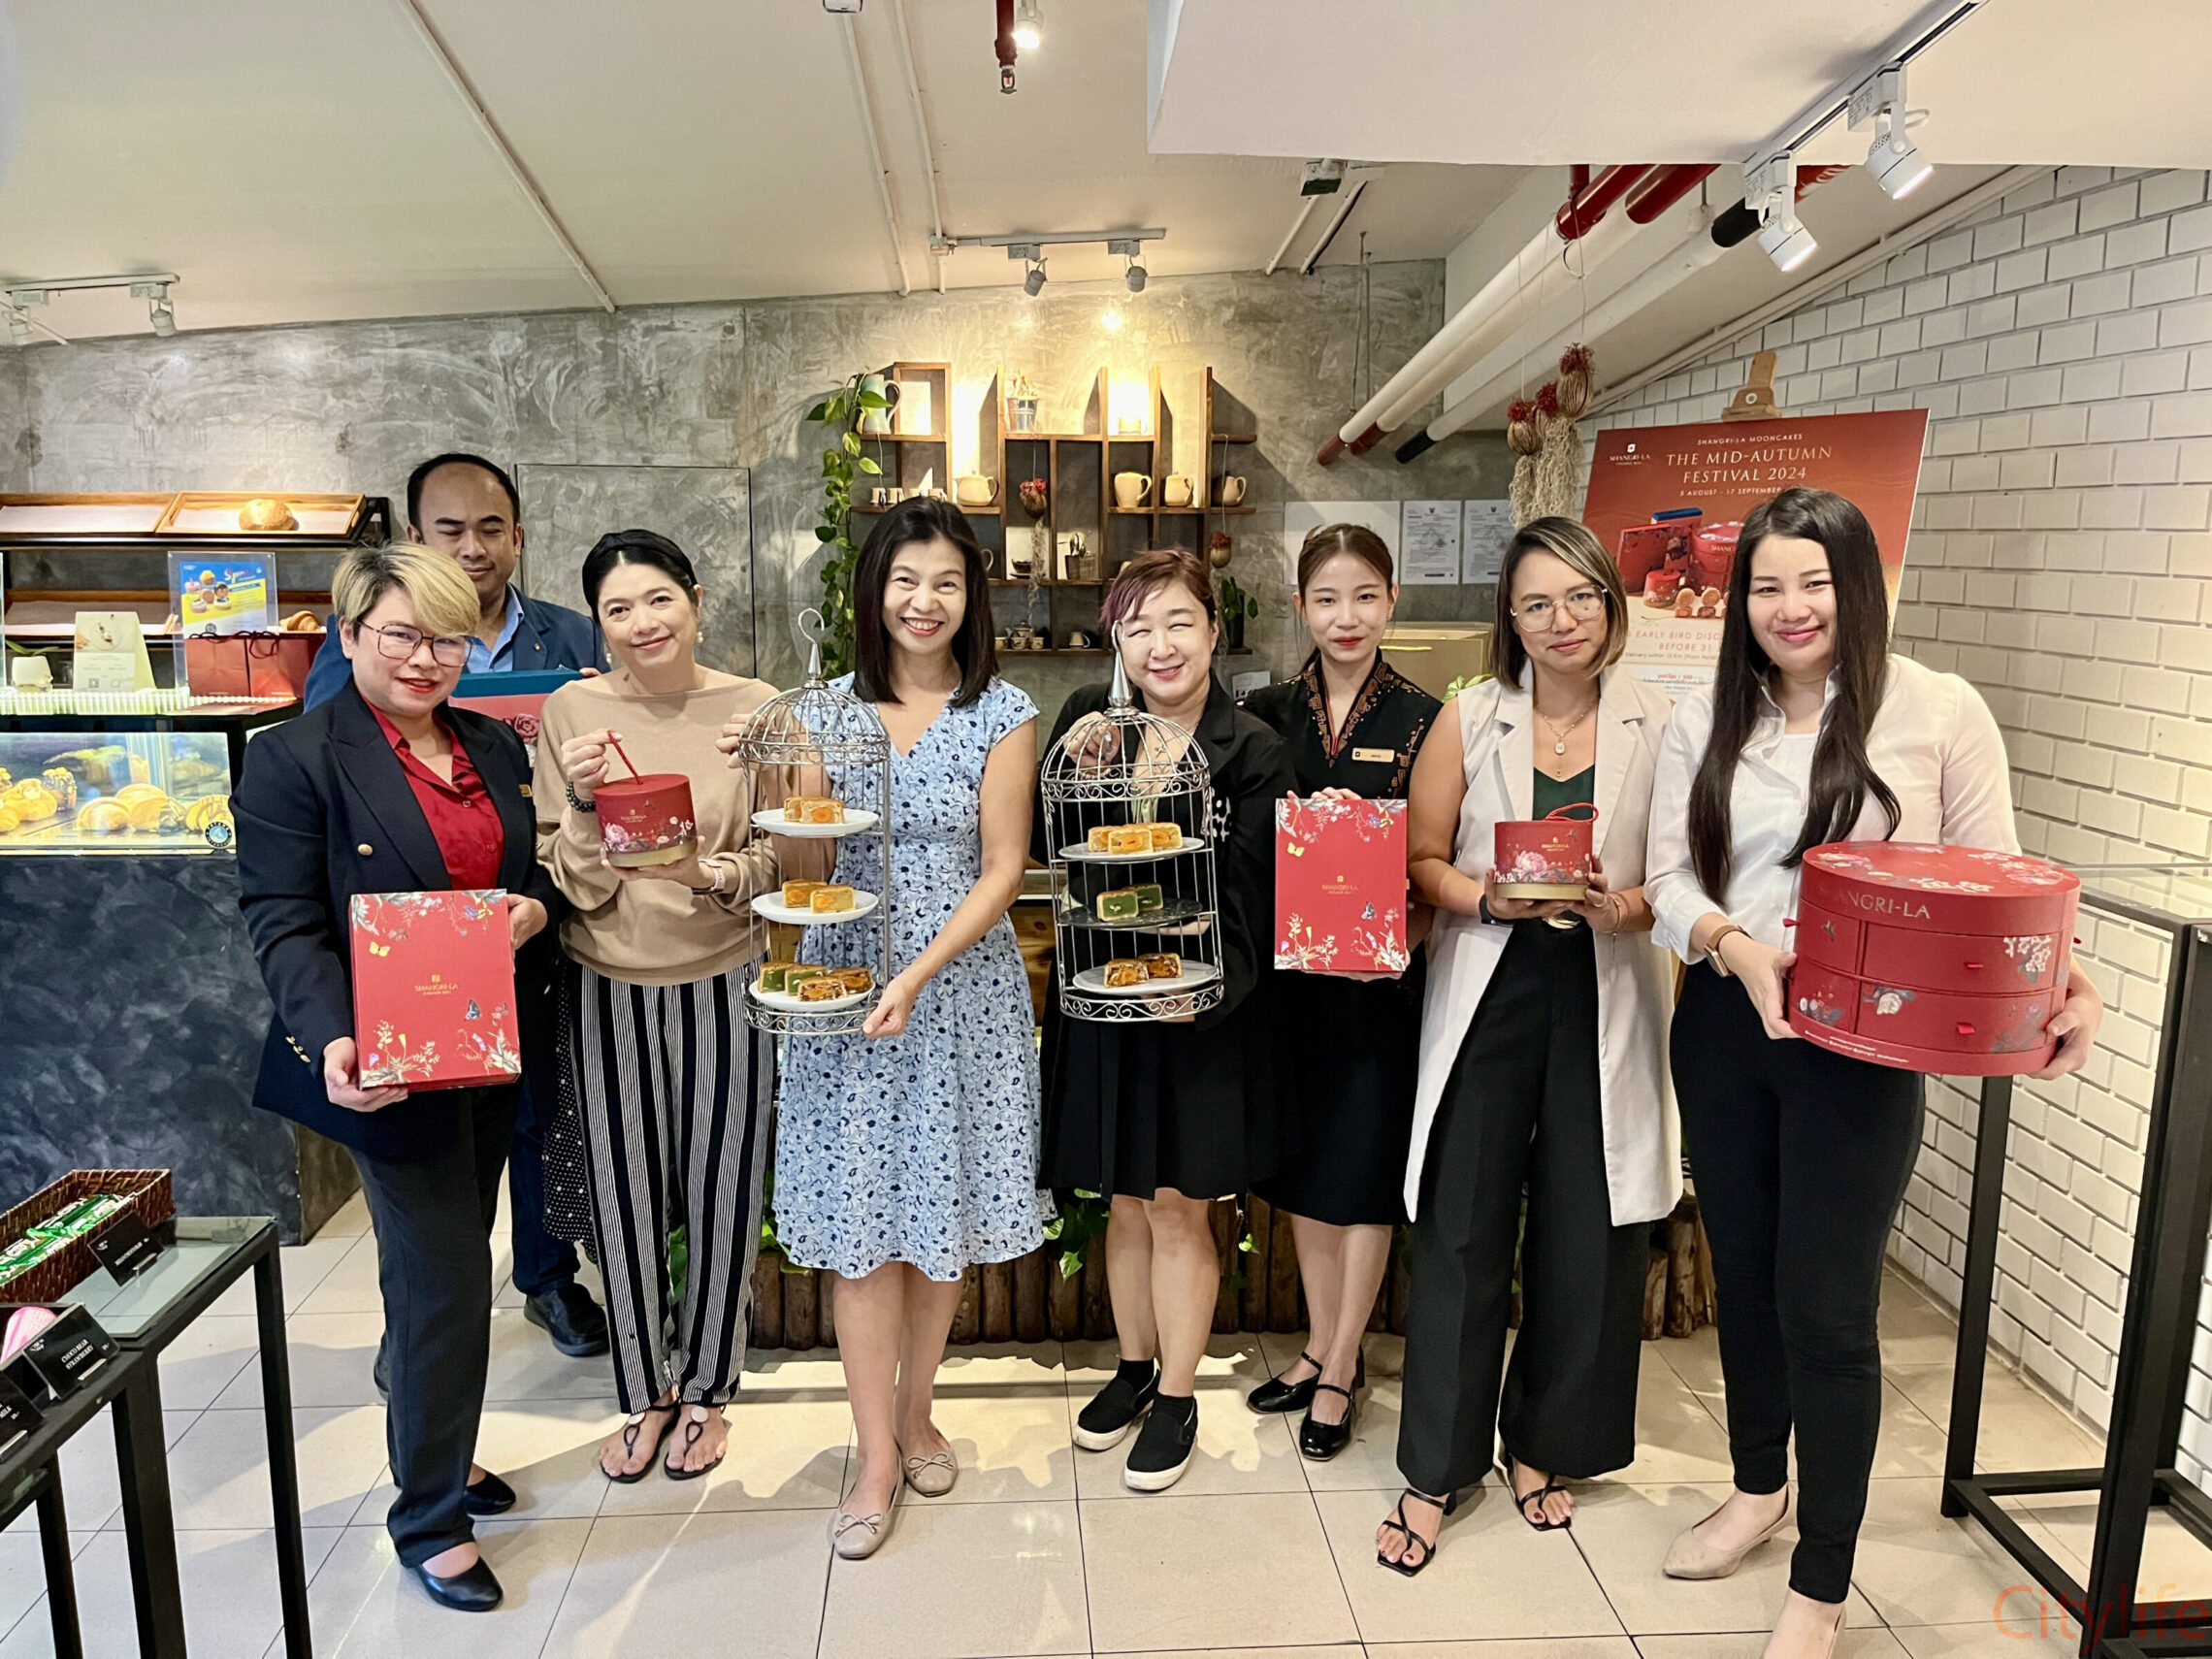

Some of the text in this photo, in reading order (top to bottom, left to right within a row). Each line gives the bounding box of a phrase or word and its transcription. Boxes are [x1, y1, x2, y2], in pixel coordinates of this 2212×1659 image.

[1749, 433, 1804, 442] MOONCAKES
[1666, 445, 1833, 467] THE MID-AUTUMN
[1682, 466, 1806, 484] FESTIVAL 2024
[1636, 630, 1723, 641] EARLY BIRD DISC
[1658, 642, 1697, 652] BEFORE
